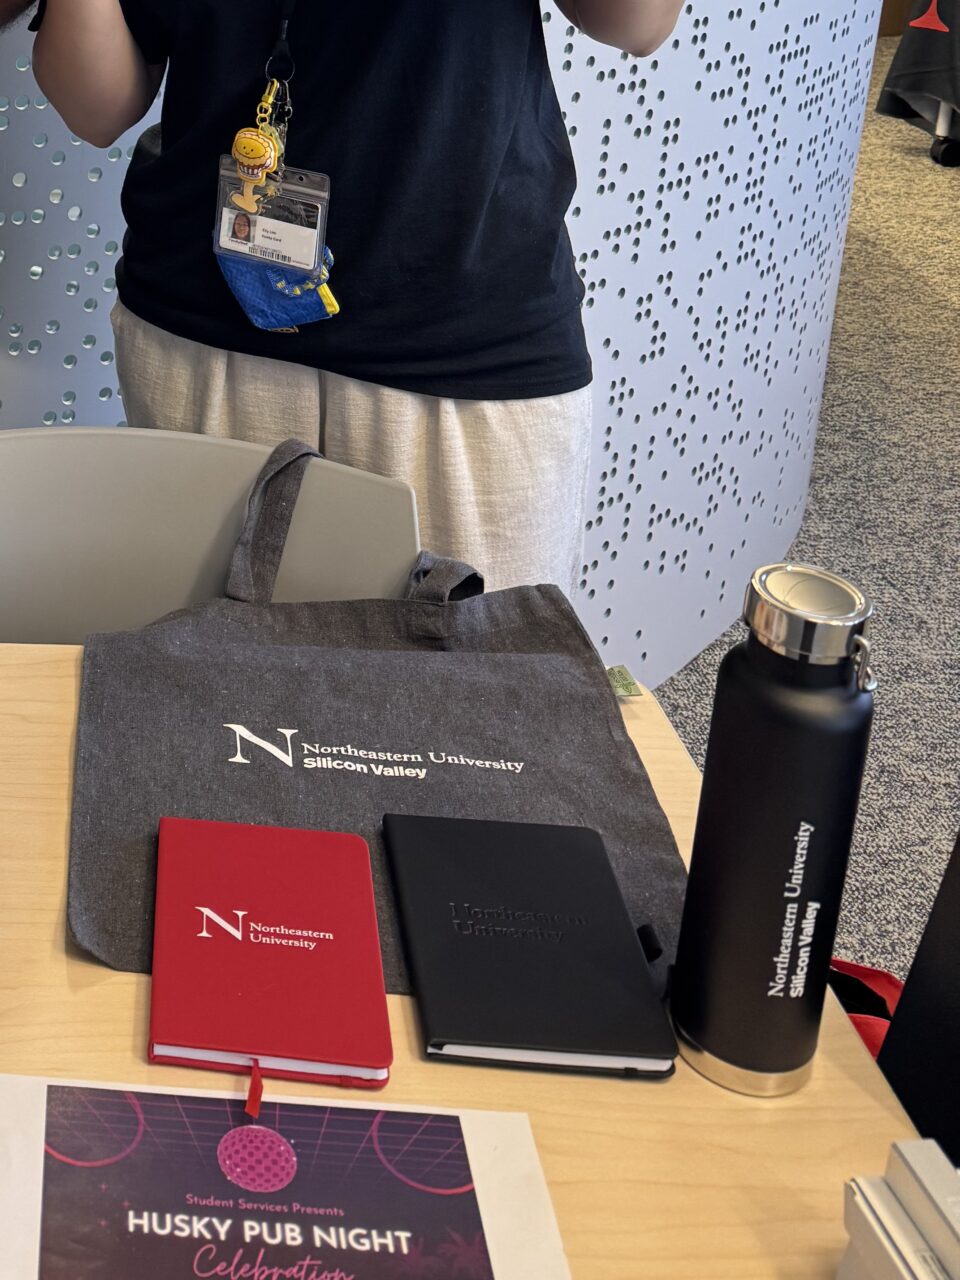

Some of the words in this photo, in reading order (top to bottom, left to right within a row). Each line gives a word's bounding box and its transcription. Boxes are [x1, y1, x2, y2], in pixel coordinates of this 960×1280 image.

[223, 723, 298, 767] N
[301, 742, 423, 762] Northeastern
[428, 751, 525, 773] University
[303, 757, 367, 773] Silicon
[370, 763, 427, 779] Valley
[194, 906, 249, 941] N
[249, 922, 334, 940] Northeastern
[767, 903, 798, 997] Northeastern
[784, 821, 815, 898] University
[798, 901, 821, 946] Valley
[249, 933, 317, 951] University
[790, 946, 811, 998] Silicon
[185, 1194, 234, 1209] Student
[238, 1198, 289, 1213] Services
[292, 1202, 344, 1217] Presents
[128, 1210, 233, 1241] HUSKY
[243, 1220, 303, 1246] PUB
[313, 1225, 412, 1254] NIGHT
[193, 1243, 355, 1280] Celebration
